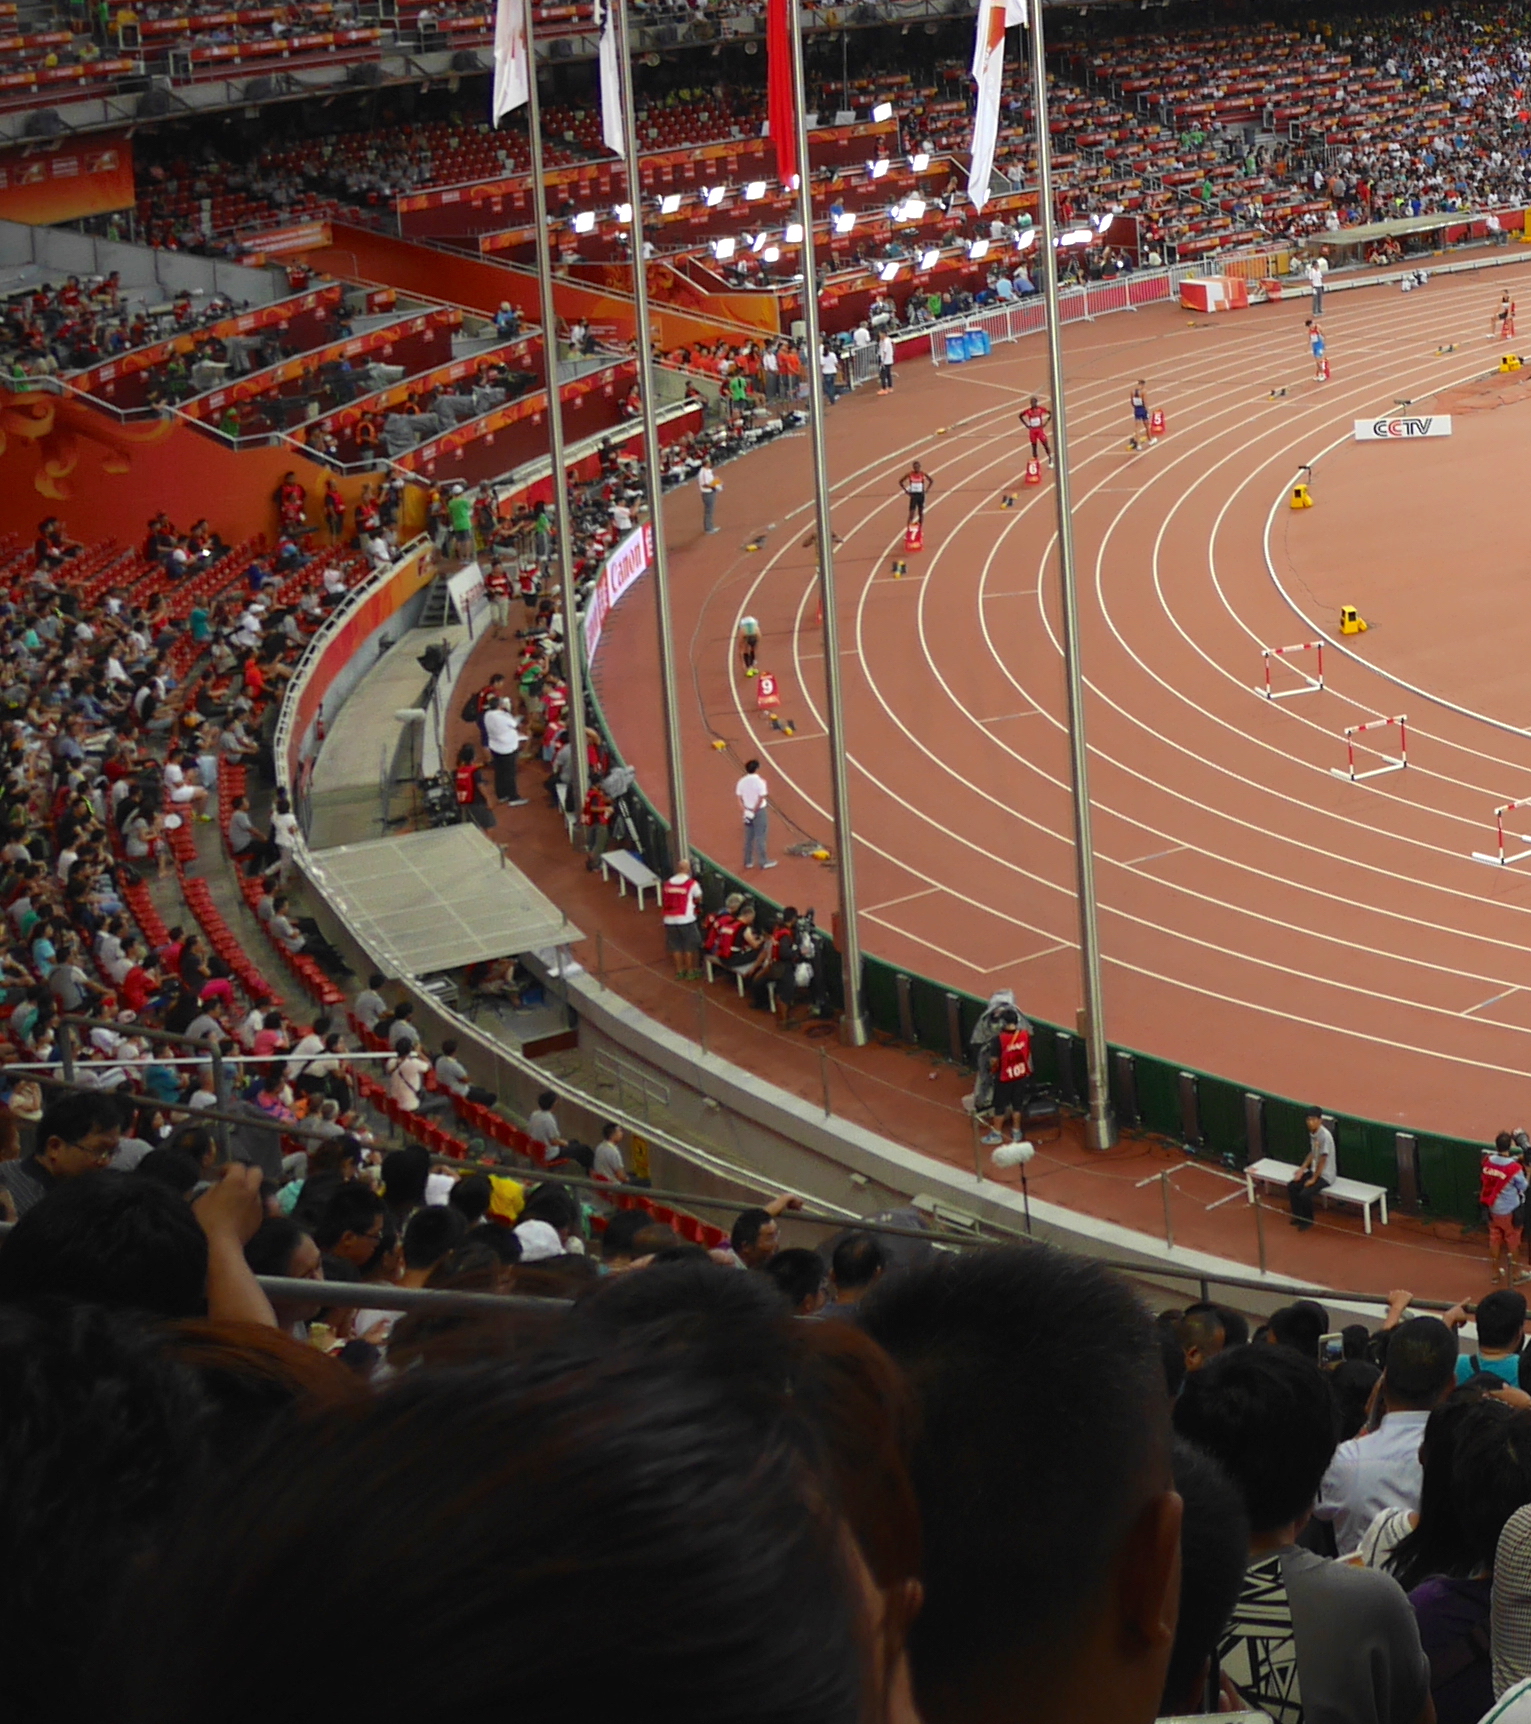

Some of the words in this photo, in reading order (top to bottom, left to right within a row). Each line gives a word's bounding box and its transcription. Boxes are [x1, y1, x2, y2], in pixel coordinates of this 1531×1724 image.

[1153, 413, 1162, 425] 5
[1374, 418, 1433, 437] CCTV
[909, 527, 919, 541] 7
[610, 542, 642, 594] Canon
[761, 679, 773, 695] 9
